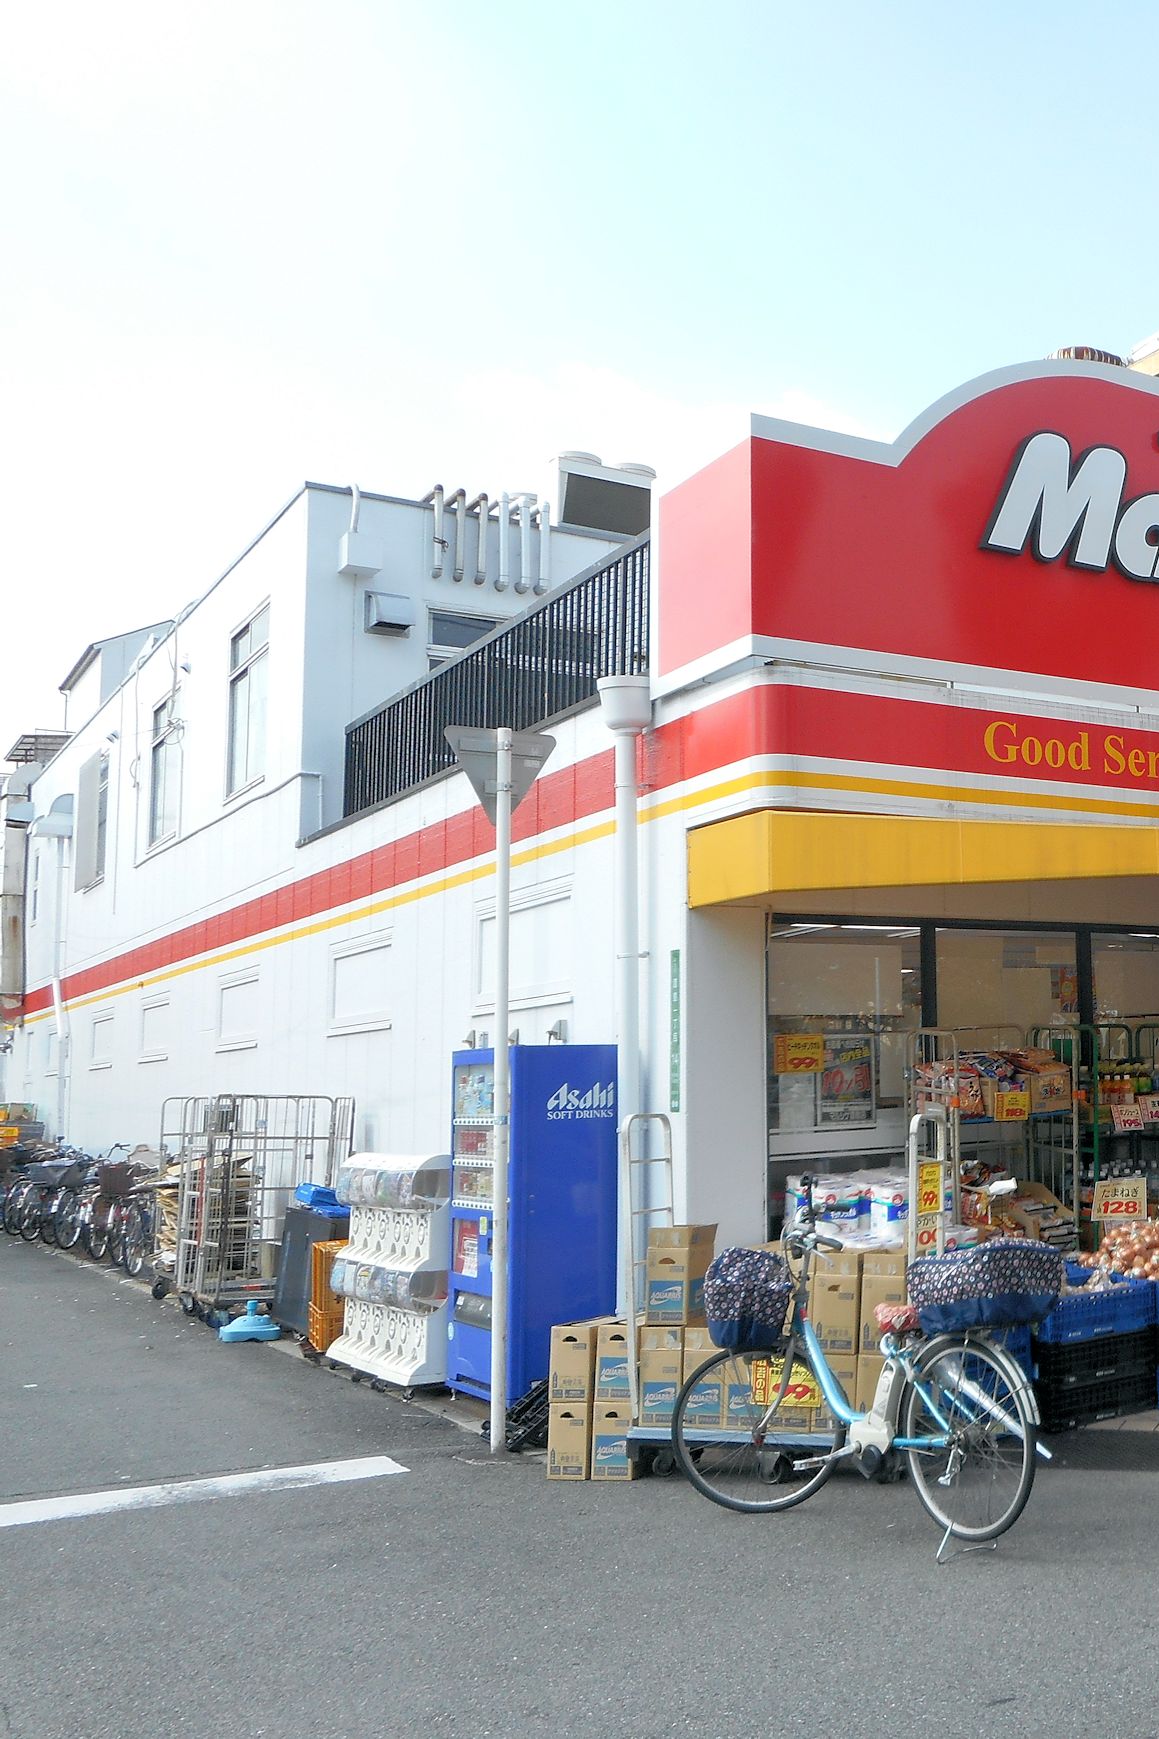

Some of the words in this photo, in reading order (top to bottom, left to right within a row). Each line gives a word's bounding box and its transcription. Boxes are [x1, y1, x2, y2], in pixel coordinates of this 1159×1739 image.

[983, 721, 1091, 771] Good
[547, 1081, 614, 1110] Asahi
[547, 1110, 573, 1120] SOFT
[575, 1109, 614, 1119] DRINKS
[1101, 1186, 1140, 1199] たまねぎ
